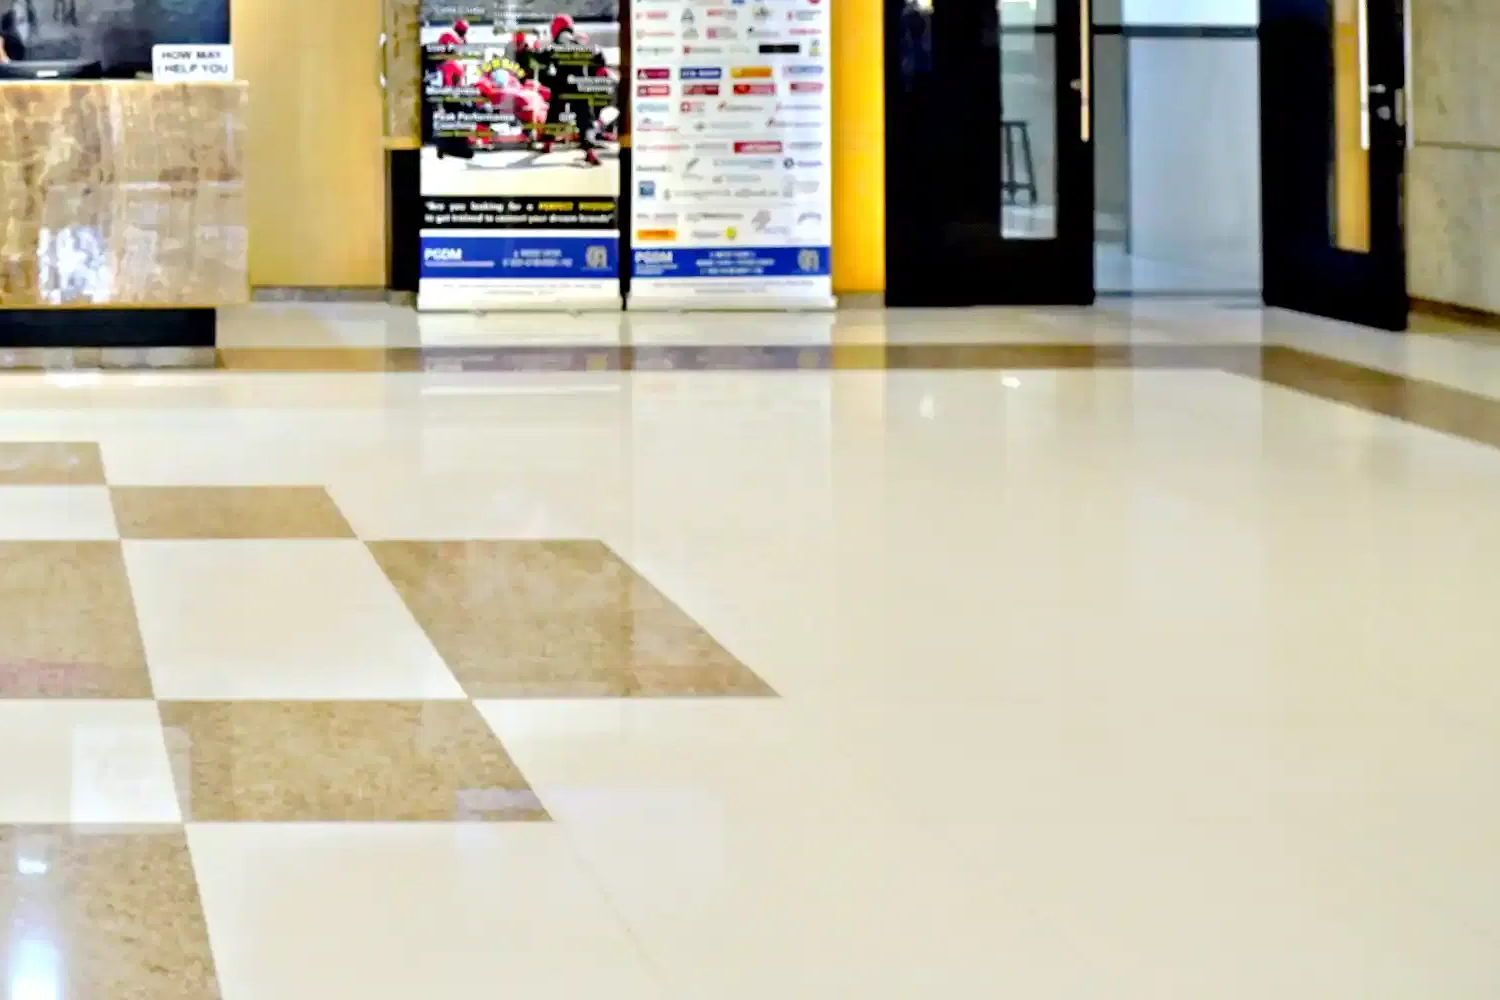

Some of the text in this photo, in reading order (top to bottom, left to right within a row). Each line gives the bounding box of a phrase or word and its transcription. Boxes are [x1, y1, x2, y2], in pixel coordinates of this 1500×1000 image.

[162, 51, 221, 60] HOW MAY
[165, 64, 197, 73] HELP
[202, 64, 228, 74] YOU
